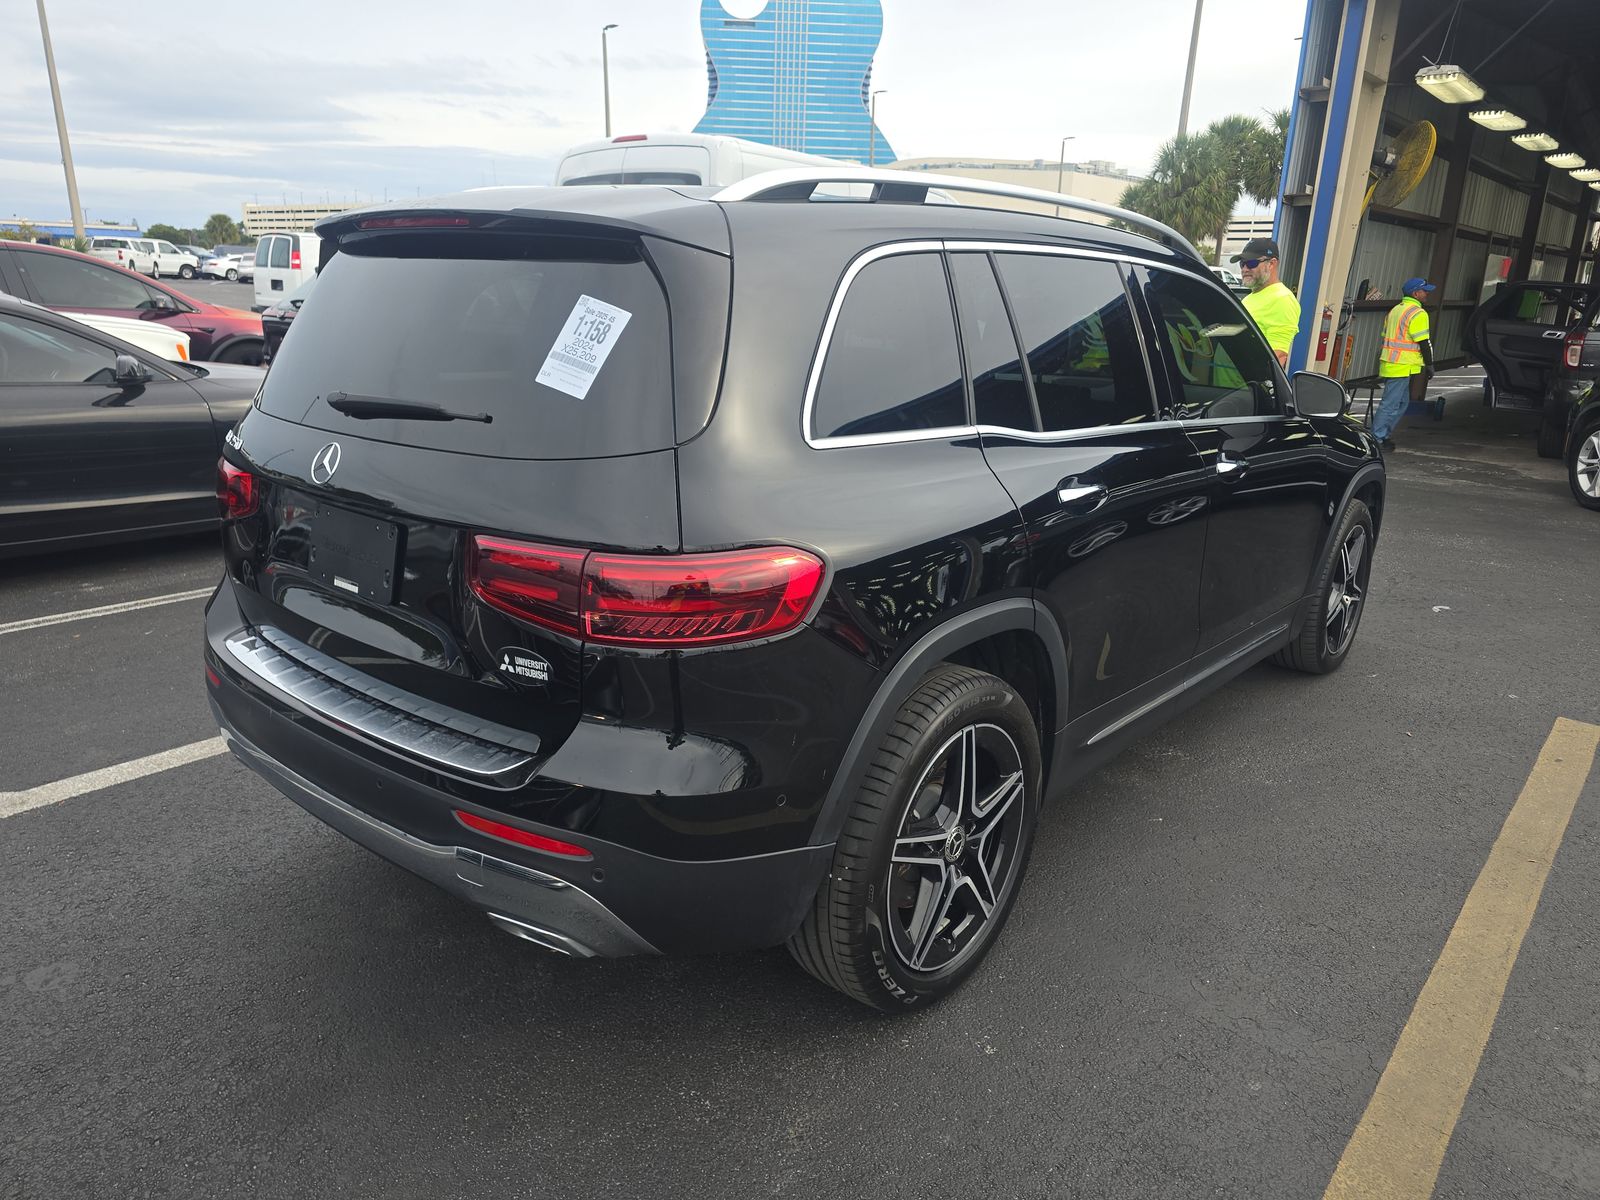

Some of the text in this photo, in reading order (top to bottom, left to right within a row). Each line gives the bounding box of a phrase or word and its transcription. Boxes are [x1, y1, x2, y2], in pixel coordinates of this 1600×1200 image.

[573, 314, 612, 345] 1:158
[572, 337, 595, 352] 2024
[561, 343, 597, 364] X25.209
[514, 656, 548, 671] UNIVERSITY
[515, 665, 549, 681] MITSUBISHI
